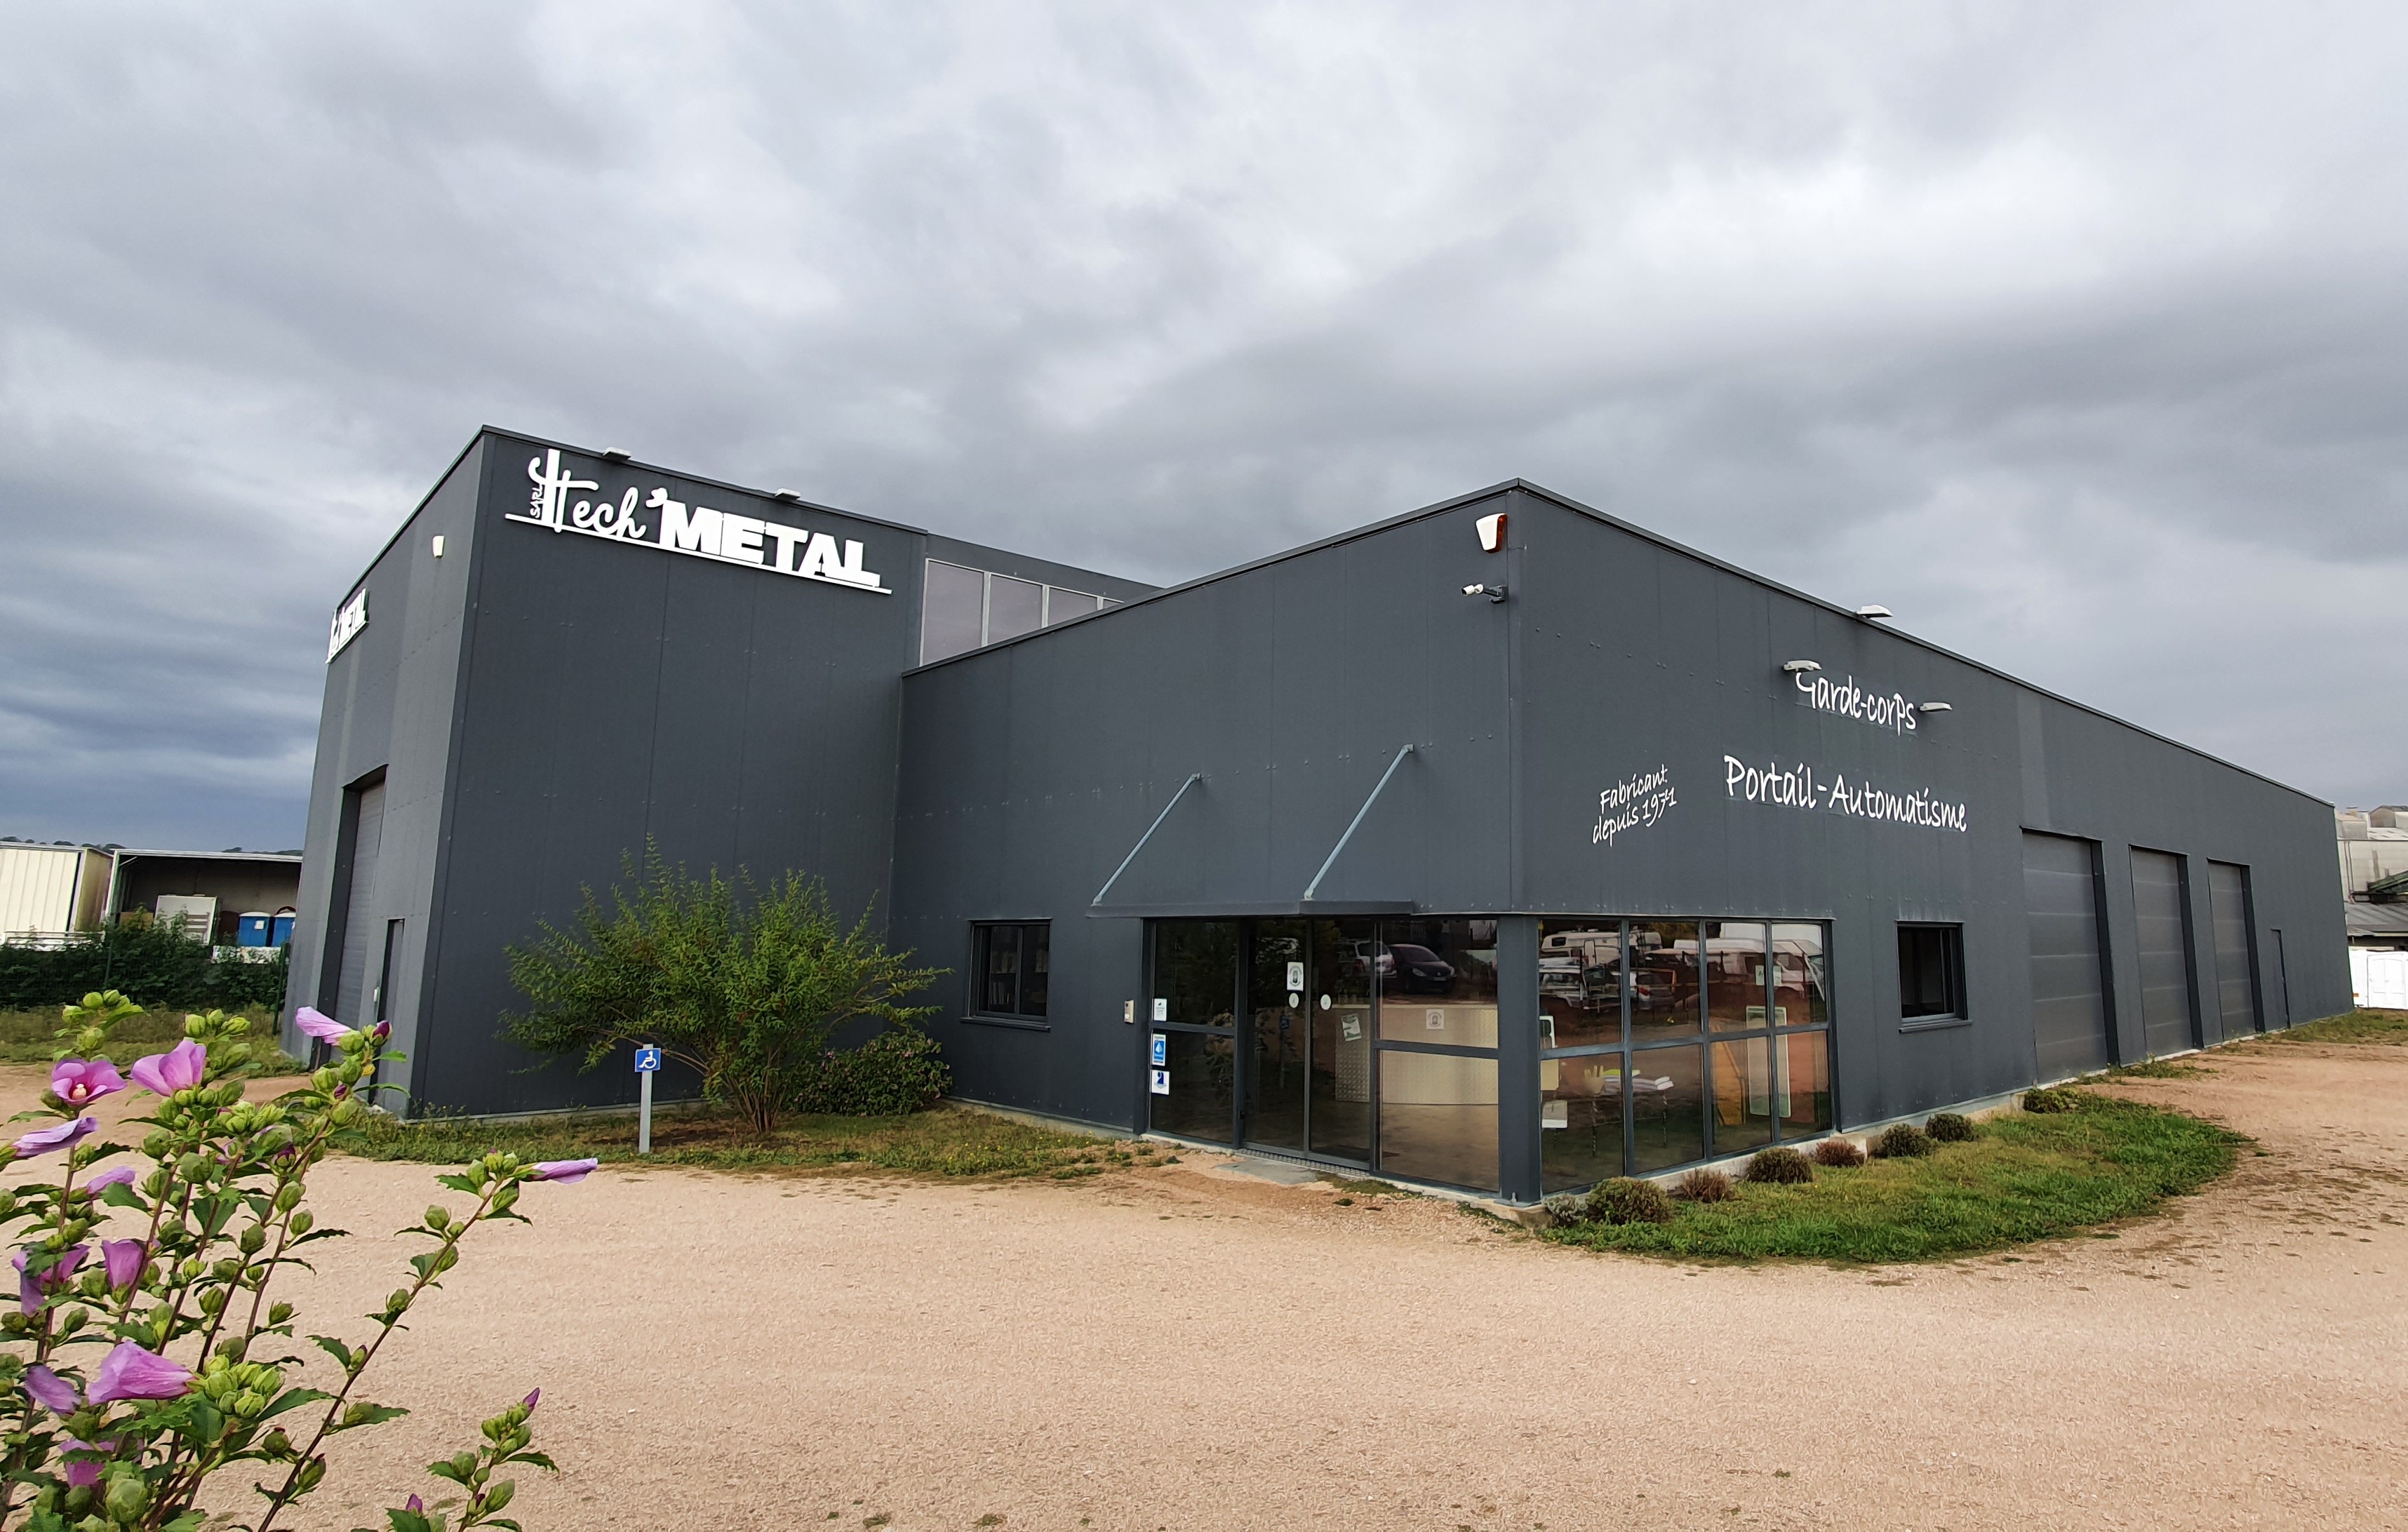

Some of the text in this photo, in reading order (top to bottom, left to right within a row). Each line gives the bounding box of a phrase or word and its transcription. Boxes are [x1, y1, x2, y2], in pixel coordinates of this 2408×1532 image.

[530, 483, 544, 518] SARL
[1795, 671, 1917, 737] Garde-corps
[1593, 786, 1678, 847] depuis 1971
[1600, 763, 1668, 814] Fabricant
[1723, 755, 1967, 833] Portail-Automatisme
